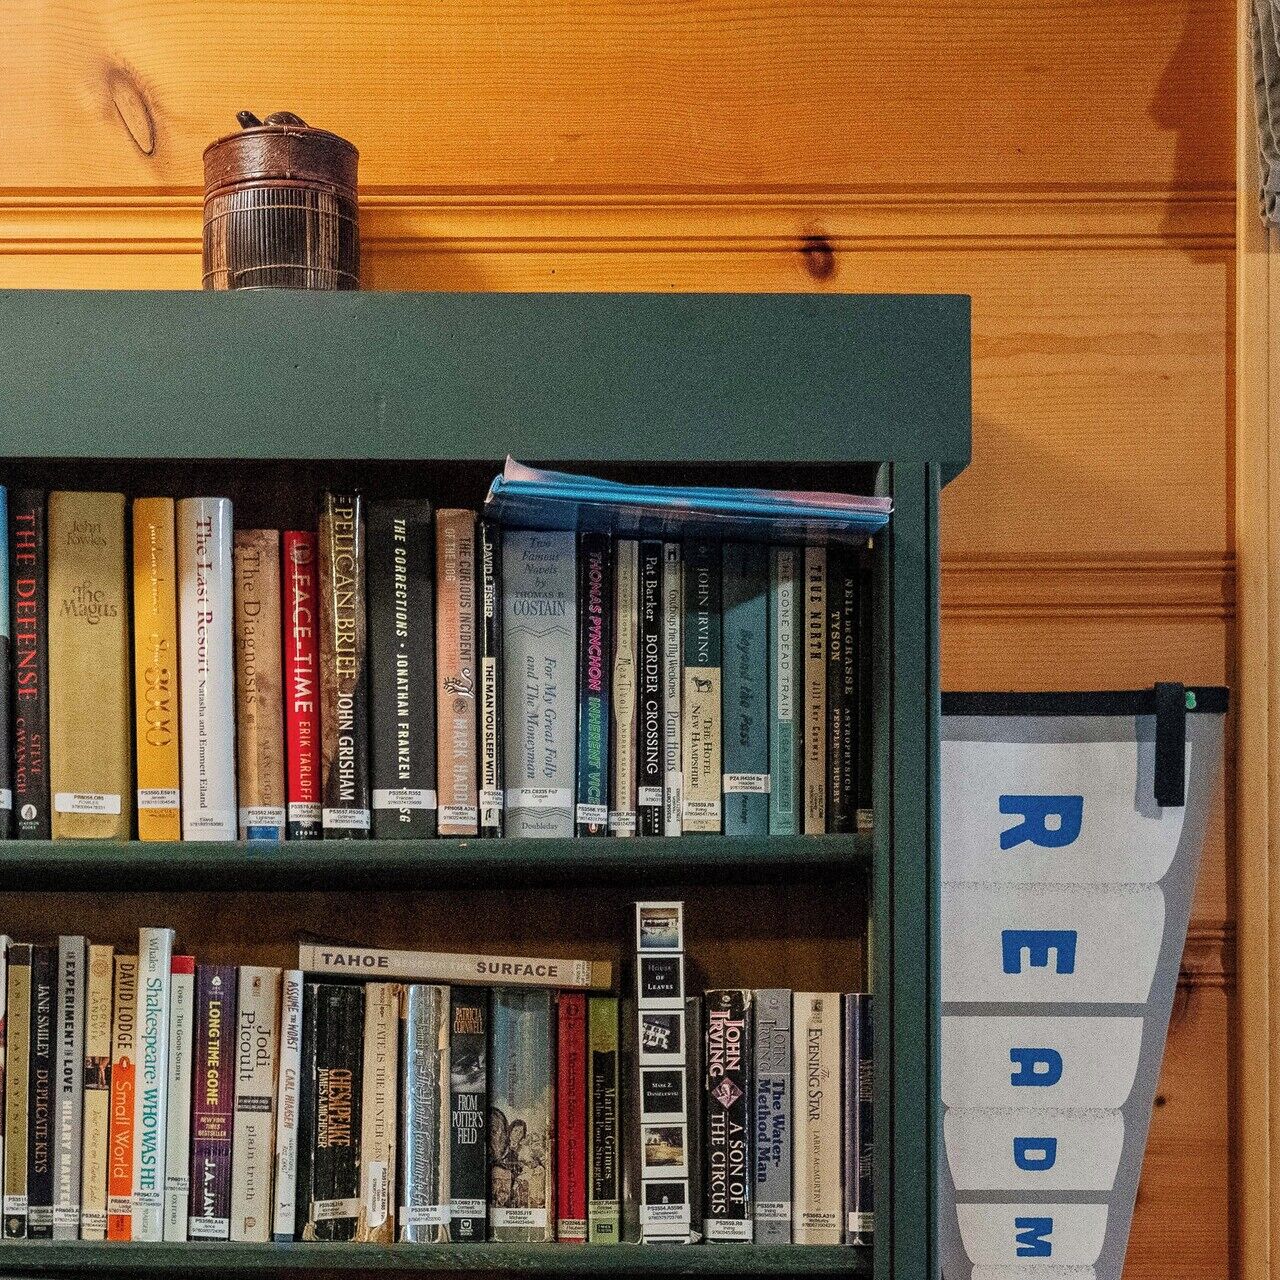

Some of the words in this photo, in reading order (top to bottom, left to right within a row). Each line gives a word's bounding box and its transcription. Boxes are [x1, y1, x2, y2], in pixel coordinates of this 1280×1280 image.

[14, 509, 39, 567] THE
[393, 518, 406, 543] THE
[644, 557, 656, 583] Pat
[697, 567, 709, 606] JOHN
[61, 599, 118, 624] Magus
[394, 547, 407, 638] CORRECTIONS
[513, 598, 566, 616] COSTAIN
[645, 587, 656, 621] Barker
[14, 578, 39, 701] DEFENSE
[335, 616, 355, 678] BRIEF
[697, 609, 709, 662] IRVING
[645, 634, 657, 693] BORDER
[396, 653, 409, 718] JONATHAN
[337, 691, 354, 732] JOHN
[298, 721, 310, 748] ERIK
[397, 723, 410, 780] FRANZEN
[647, 700, 659, 775] CROSSING
[298, 752, 313, 800] TARLOFF
[338, 736, 356, 800] GRISHAM
[321, 953, 389, 968] TAHOE
[476, 961, 559, 977] SURFACE
[119, 963, 132, 1002] DAVID
[647, 983, 673, 991] LEAVES
[998, 794, 1084, 1172] READ
[117, 1008, 131, 1048] LODGE
[208, 1000, 220, 1036] LONG
[208, 1039, 219, 1070] TIME
[240, 1011, 256, 1081] Picoult
[257, 1024, 271, 1067] Jodi
[709, 1009, 723, 1077] IRVING
[726, 1015, 743, 1071] JOHN
[807, 1028, 822, 1088] EVENING
[114, 1083, 130, 1124] Small
[207, 1073, 218, 1105] GONE
[807, 1092, 820, 1122] STAR
[457, 1127, 477, 1144] FIELD
[711, 1111, 726, 1144] THE
[113, 1128, 130, 1178] World
[711, 1152, 727, 1214] CIRCUS
